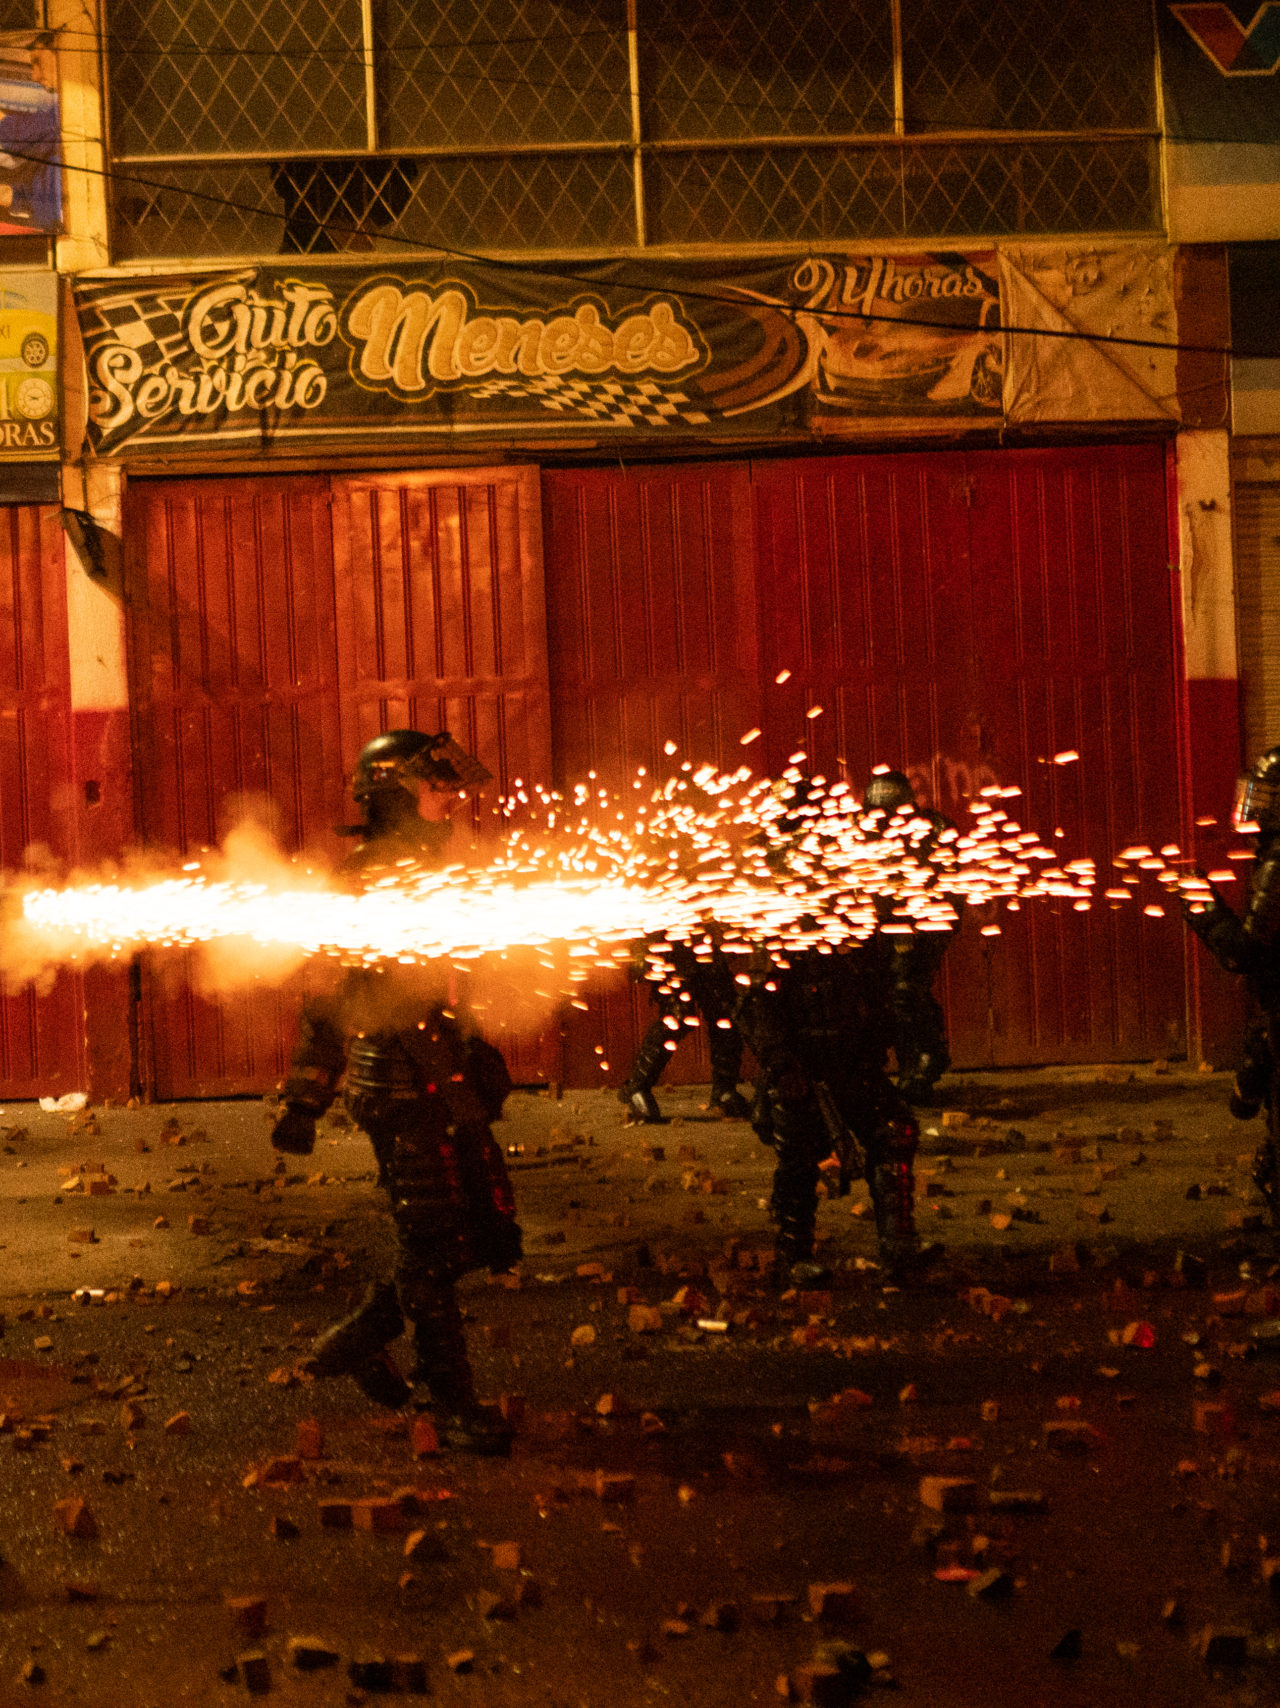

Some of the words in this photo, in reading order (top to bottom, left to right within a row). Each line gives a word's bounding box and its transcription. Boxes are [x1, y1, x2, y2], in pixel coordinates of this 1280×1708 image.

[880, 258, 983, 301] horas
[188, 284, 338, 360] Auto
[346, 284, 700, 391] Meneses
[90, 345, 328, 428] Servicio
